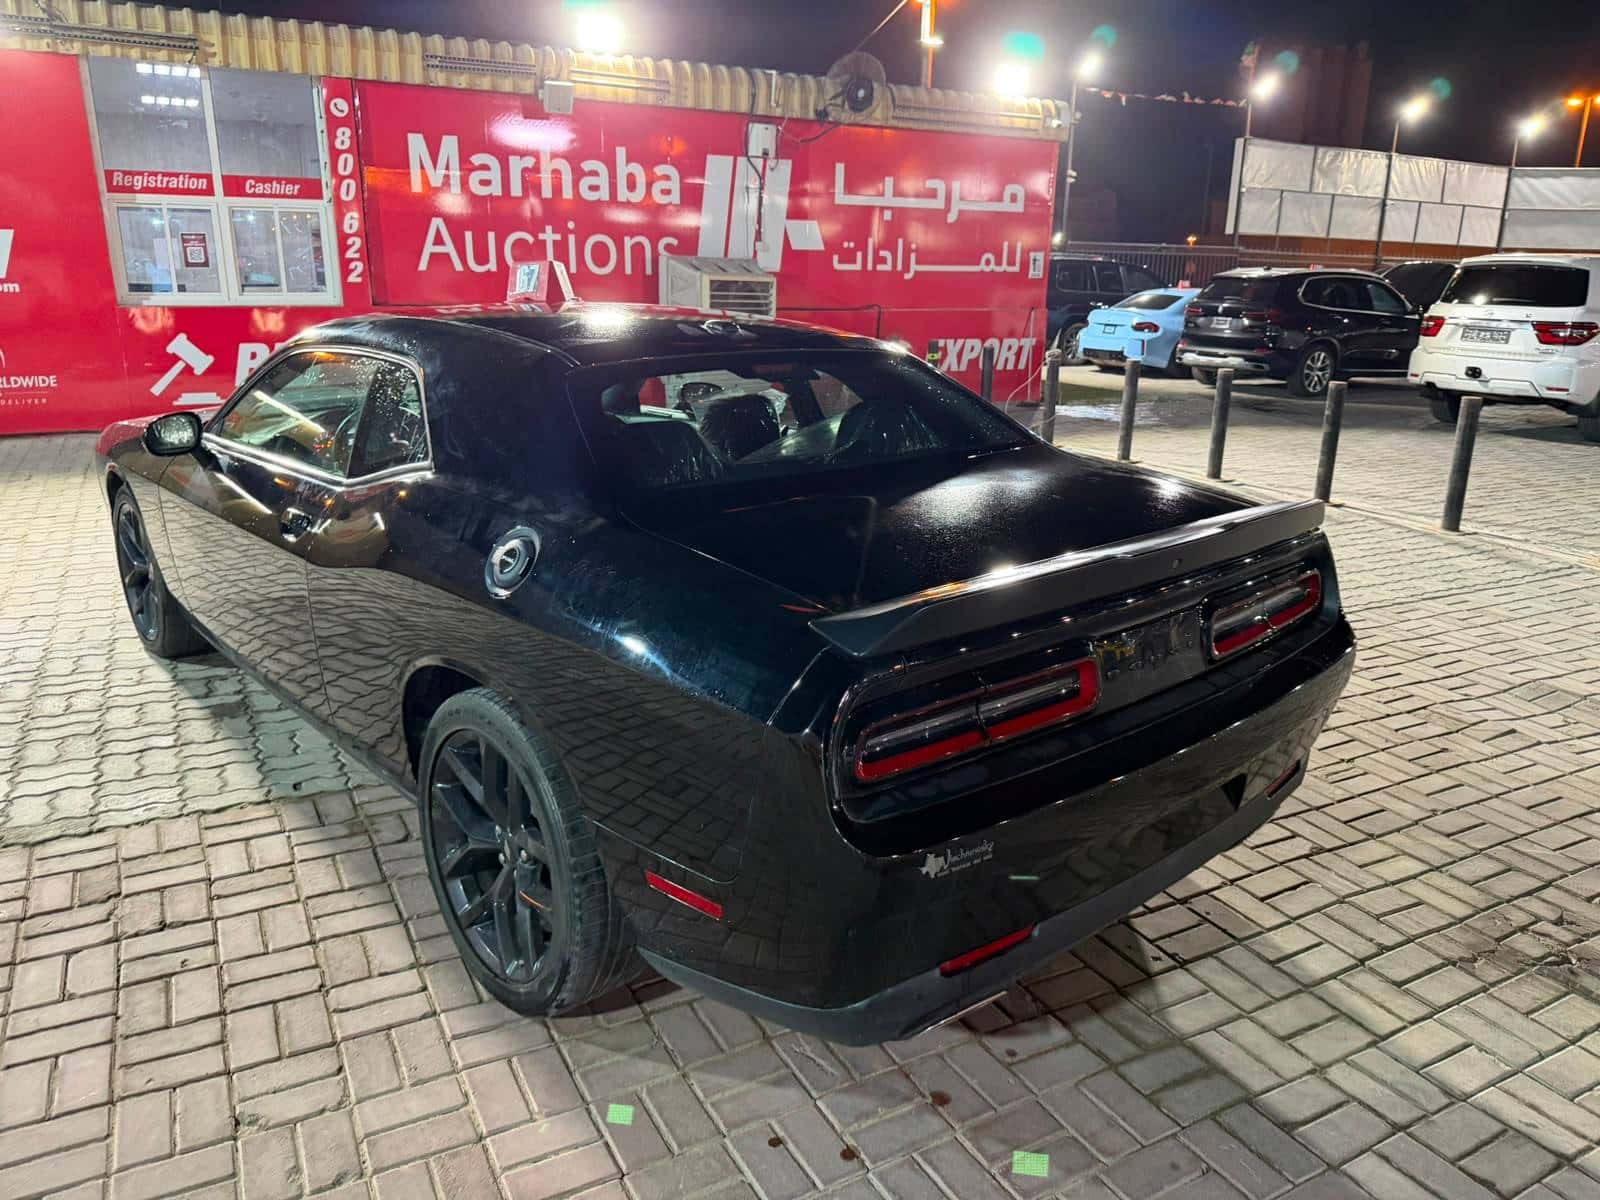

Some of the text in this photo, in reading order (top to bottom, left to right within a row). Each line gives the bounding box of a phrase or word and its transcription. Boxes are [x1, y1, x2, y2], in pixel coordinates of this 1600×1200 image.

[112, 171, 208, 191] Registration
[245, 179, 301, 196] Cashier
[406, 132, 681, 205] Marhaba
[334, 126, 364, 284] 800 622
[834, 162, 1025, 223] مرحبا
[832, 237, 1022, 280] للمزادات
[0, 375, 58, 388] LDWIDE
